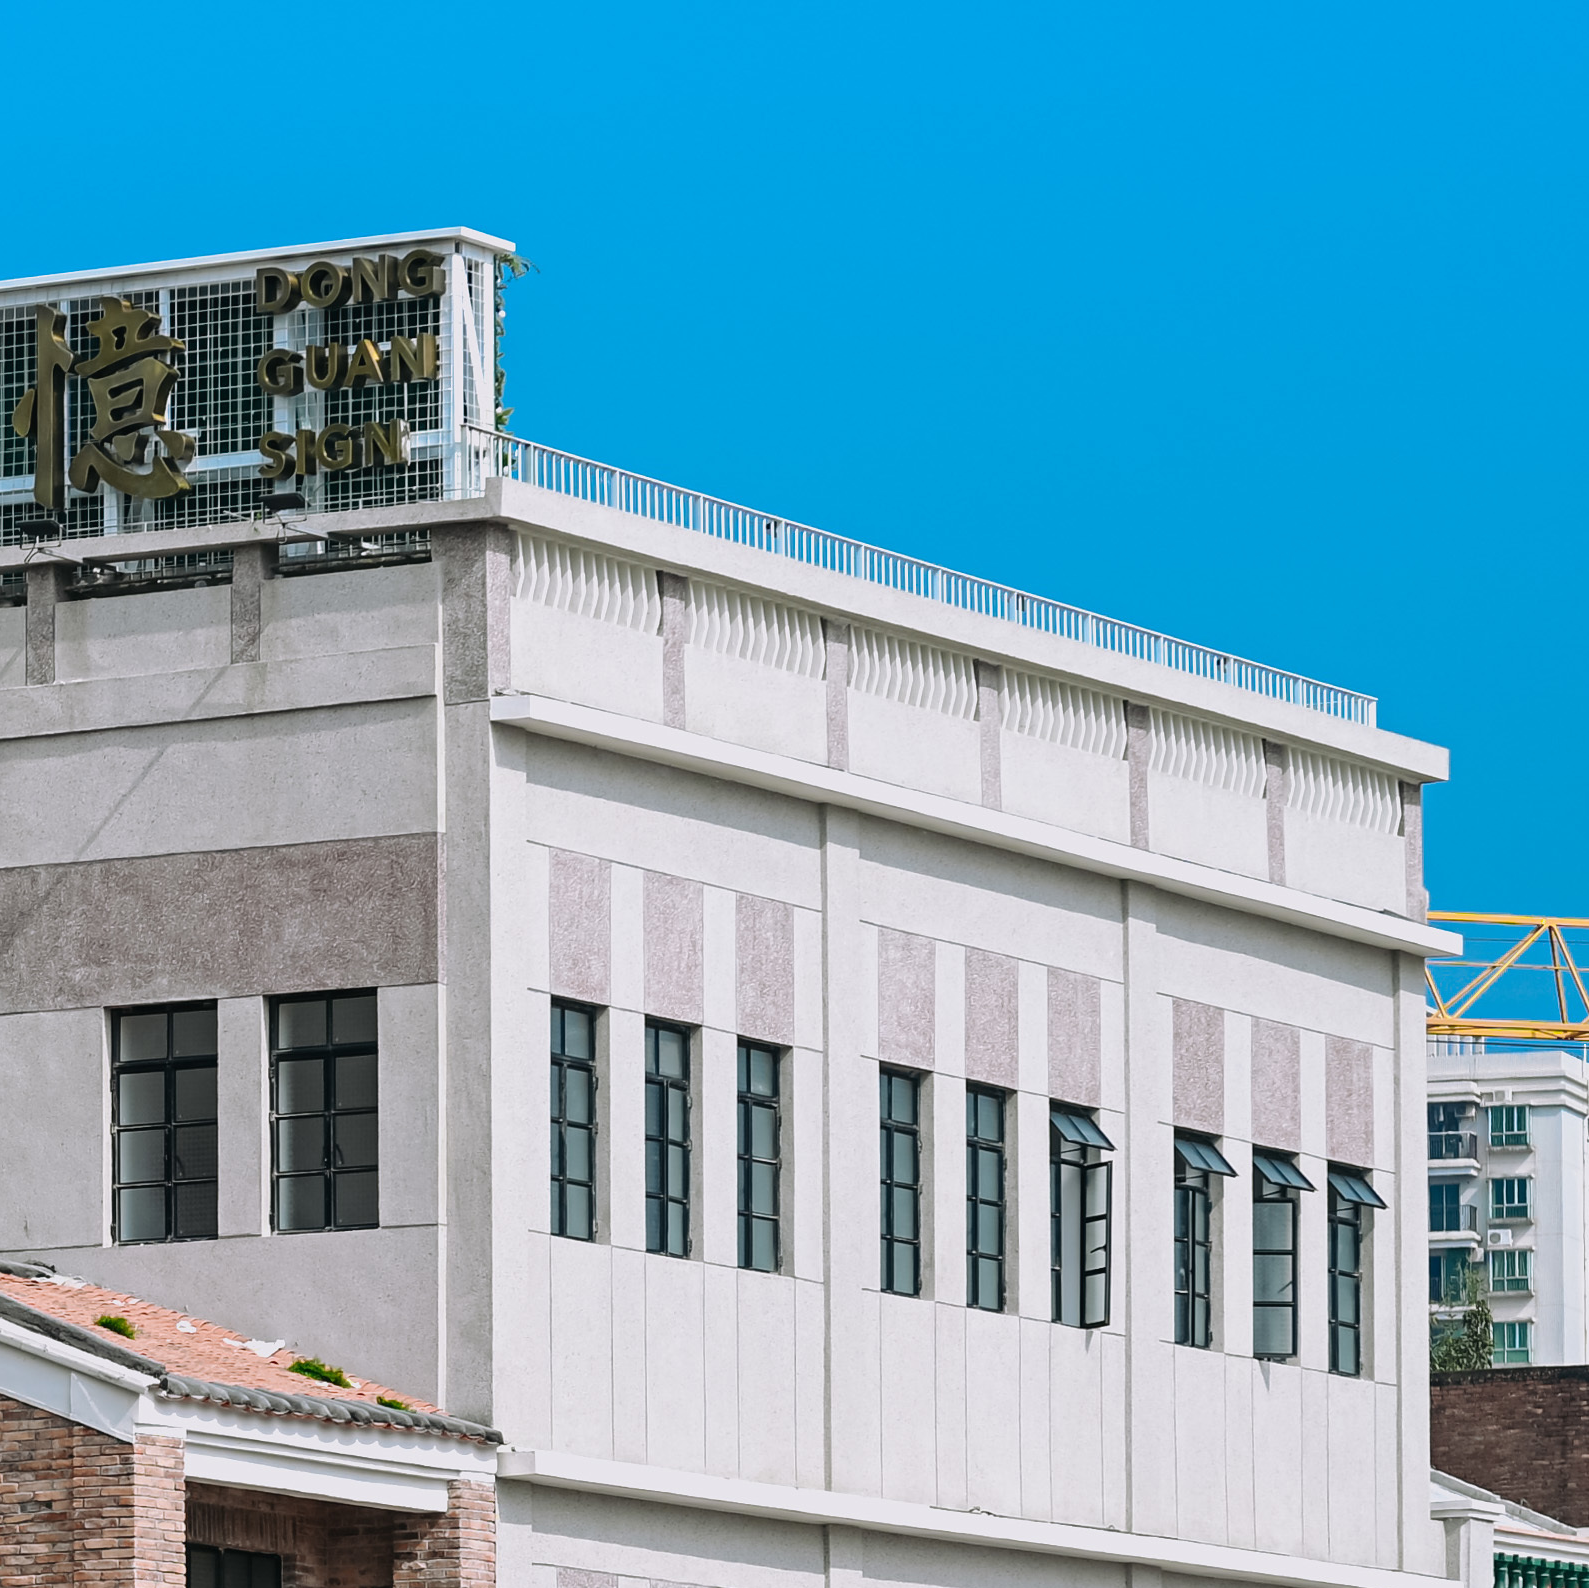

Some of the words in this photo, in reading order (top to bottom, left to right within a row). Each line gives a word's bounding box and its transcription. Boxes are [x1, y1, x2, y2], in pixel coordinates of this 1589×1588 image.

[256, 249, 447, 315] DONG
[257, 333, 437, 397] GUAN
[258, 418, 411, 481] SIGN
